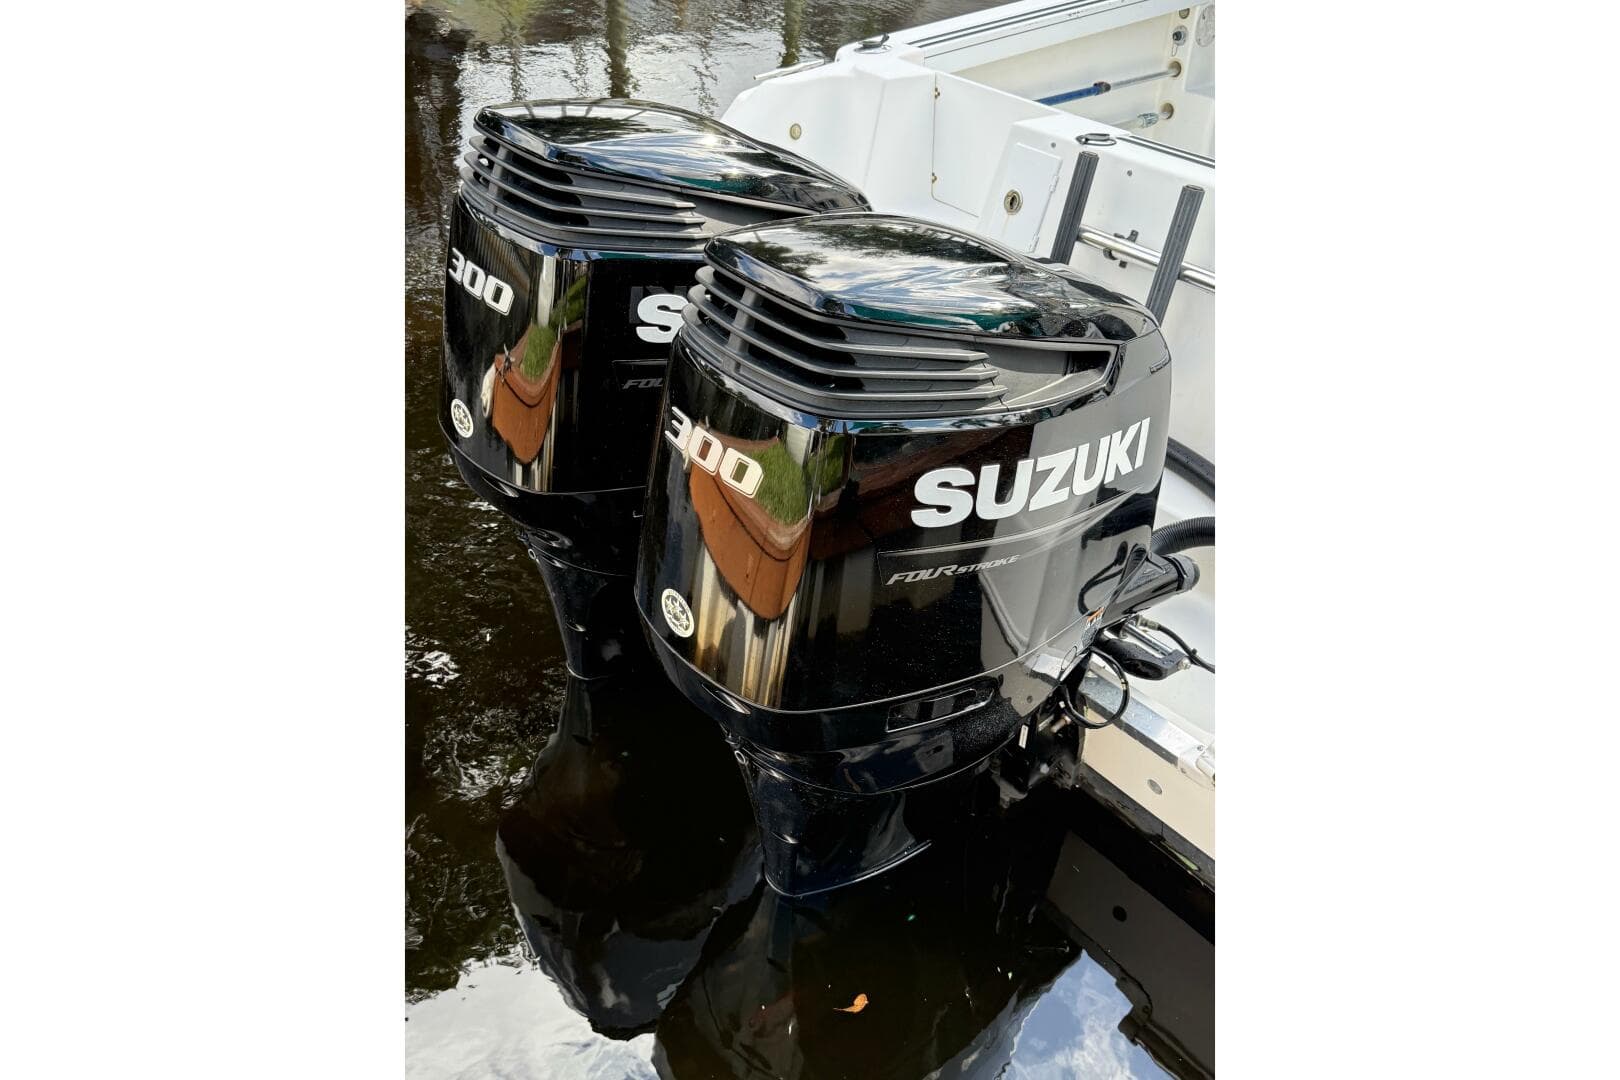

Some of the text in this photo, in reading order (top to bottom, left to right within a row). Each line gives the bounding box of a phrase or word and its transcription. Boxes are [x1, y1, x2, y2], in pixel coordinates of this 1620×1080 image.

[448, 248, 514, 315] 300
[664, 406, 764, 498] 300
[911, 417, 1151, 528] SUZUKI
